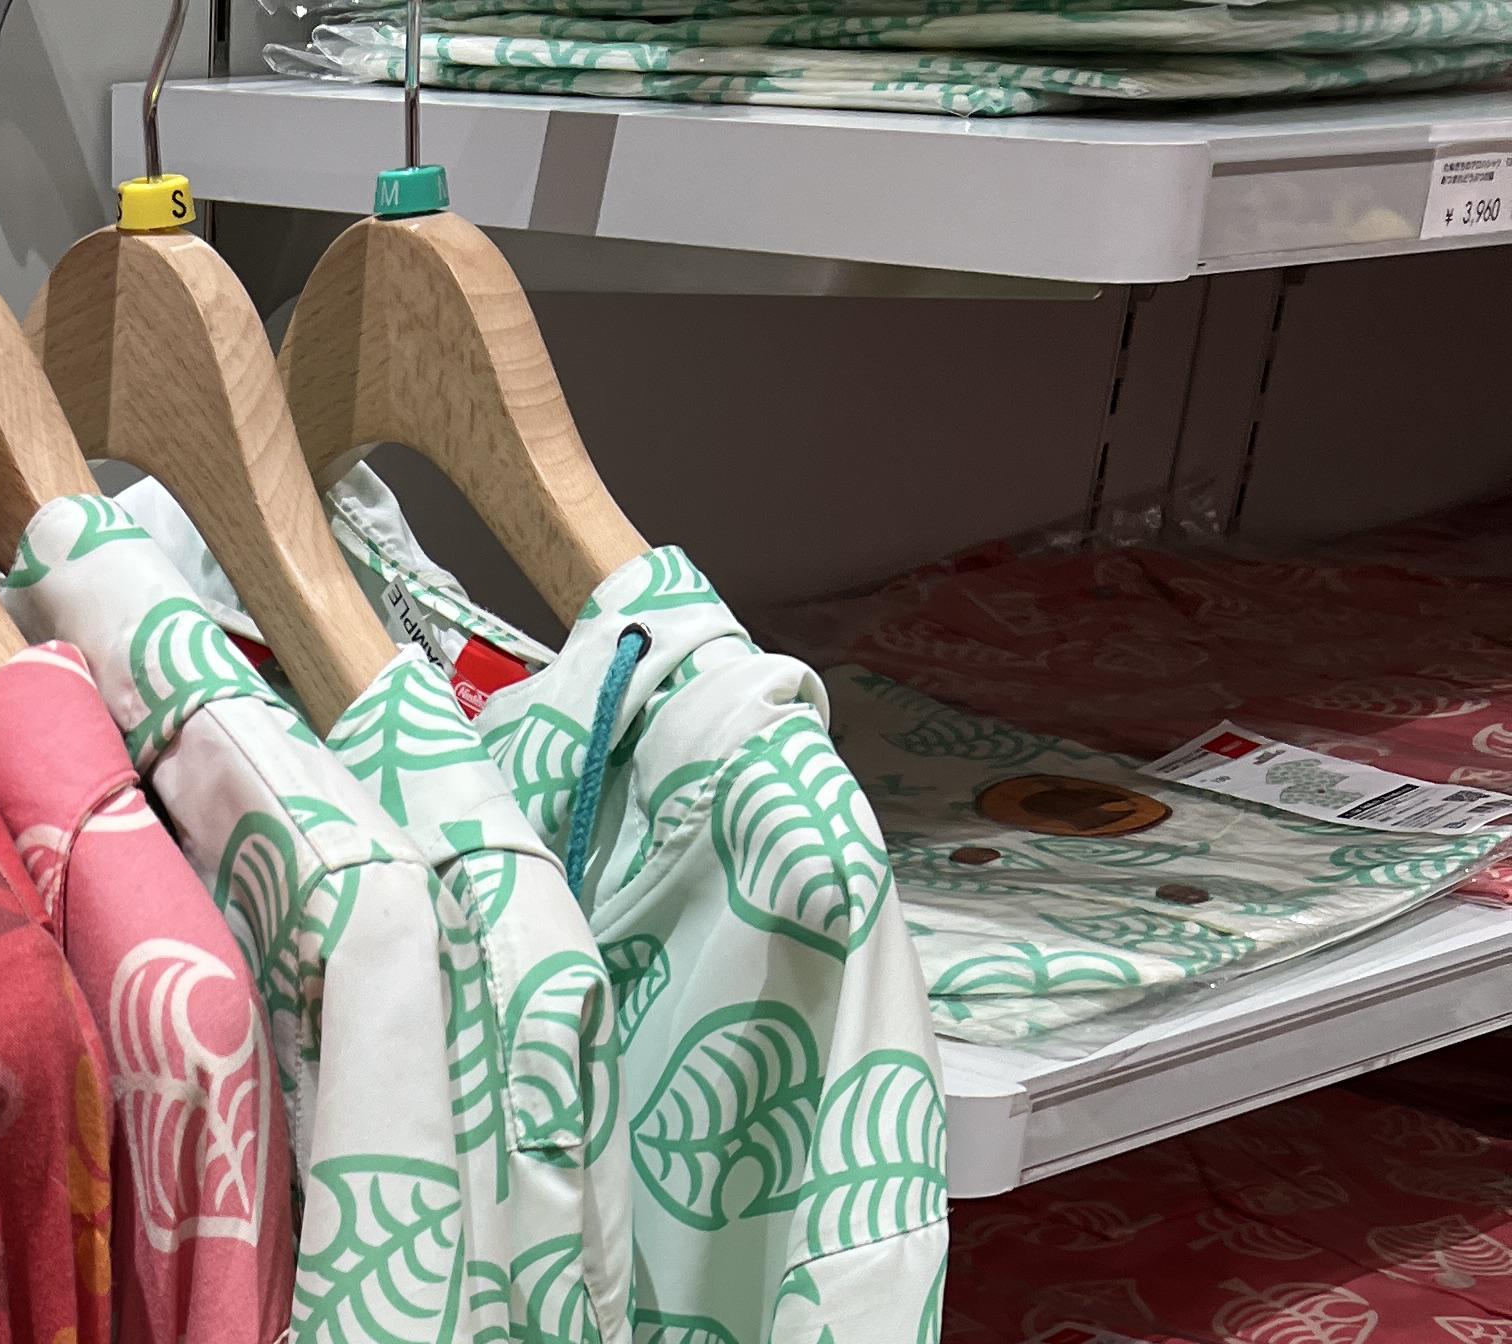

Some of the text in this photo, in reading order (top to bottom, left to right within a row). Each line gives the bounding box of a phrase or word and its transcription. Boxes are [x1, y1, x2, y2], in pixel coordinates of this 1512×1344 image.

[171, 189, 187, 219] S
[380, 179, 399, 208] M
[1462, 197, 1501, 226] 3,960
